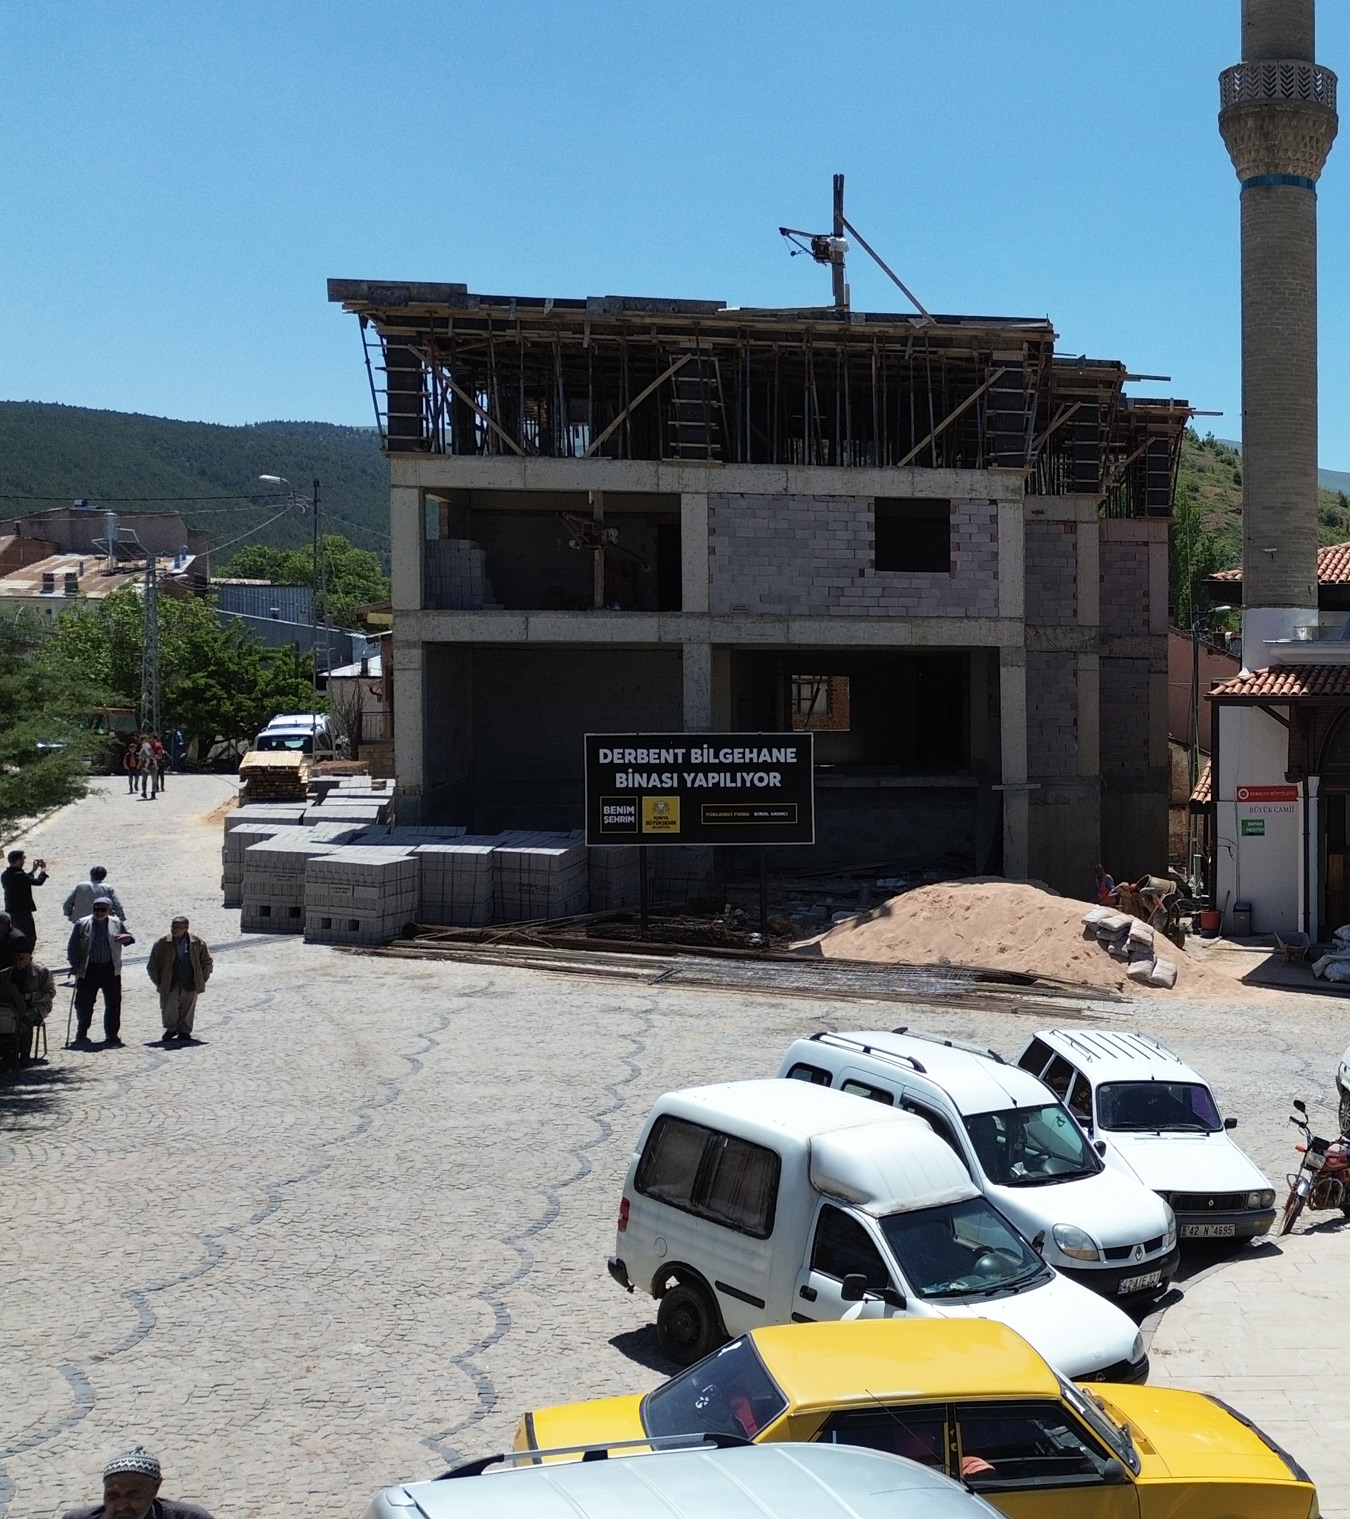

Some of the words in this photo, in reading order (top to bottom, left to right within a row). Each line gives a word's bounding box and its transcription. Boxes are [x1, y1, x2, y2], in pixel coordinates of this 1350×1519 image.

[600, 748, 686, 764] DERBENT
[691, 744, 797, 763] BİLGEHANE
[615, 768, 678, 788] BİNASI
[683, 772, 782, 787] YAPILIYOR
[603, 805, 635, 815] BENİM
[1249, 805, 1273, 814] BÜYÜK
[603, 815, 635, 825] ŞEHRİM
[1189, 1226, 1199, 1236] 42
[1203, 1226, 1209, 1236] N
